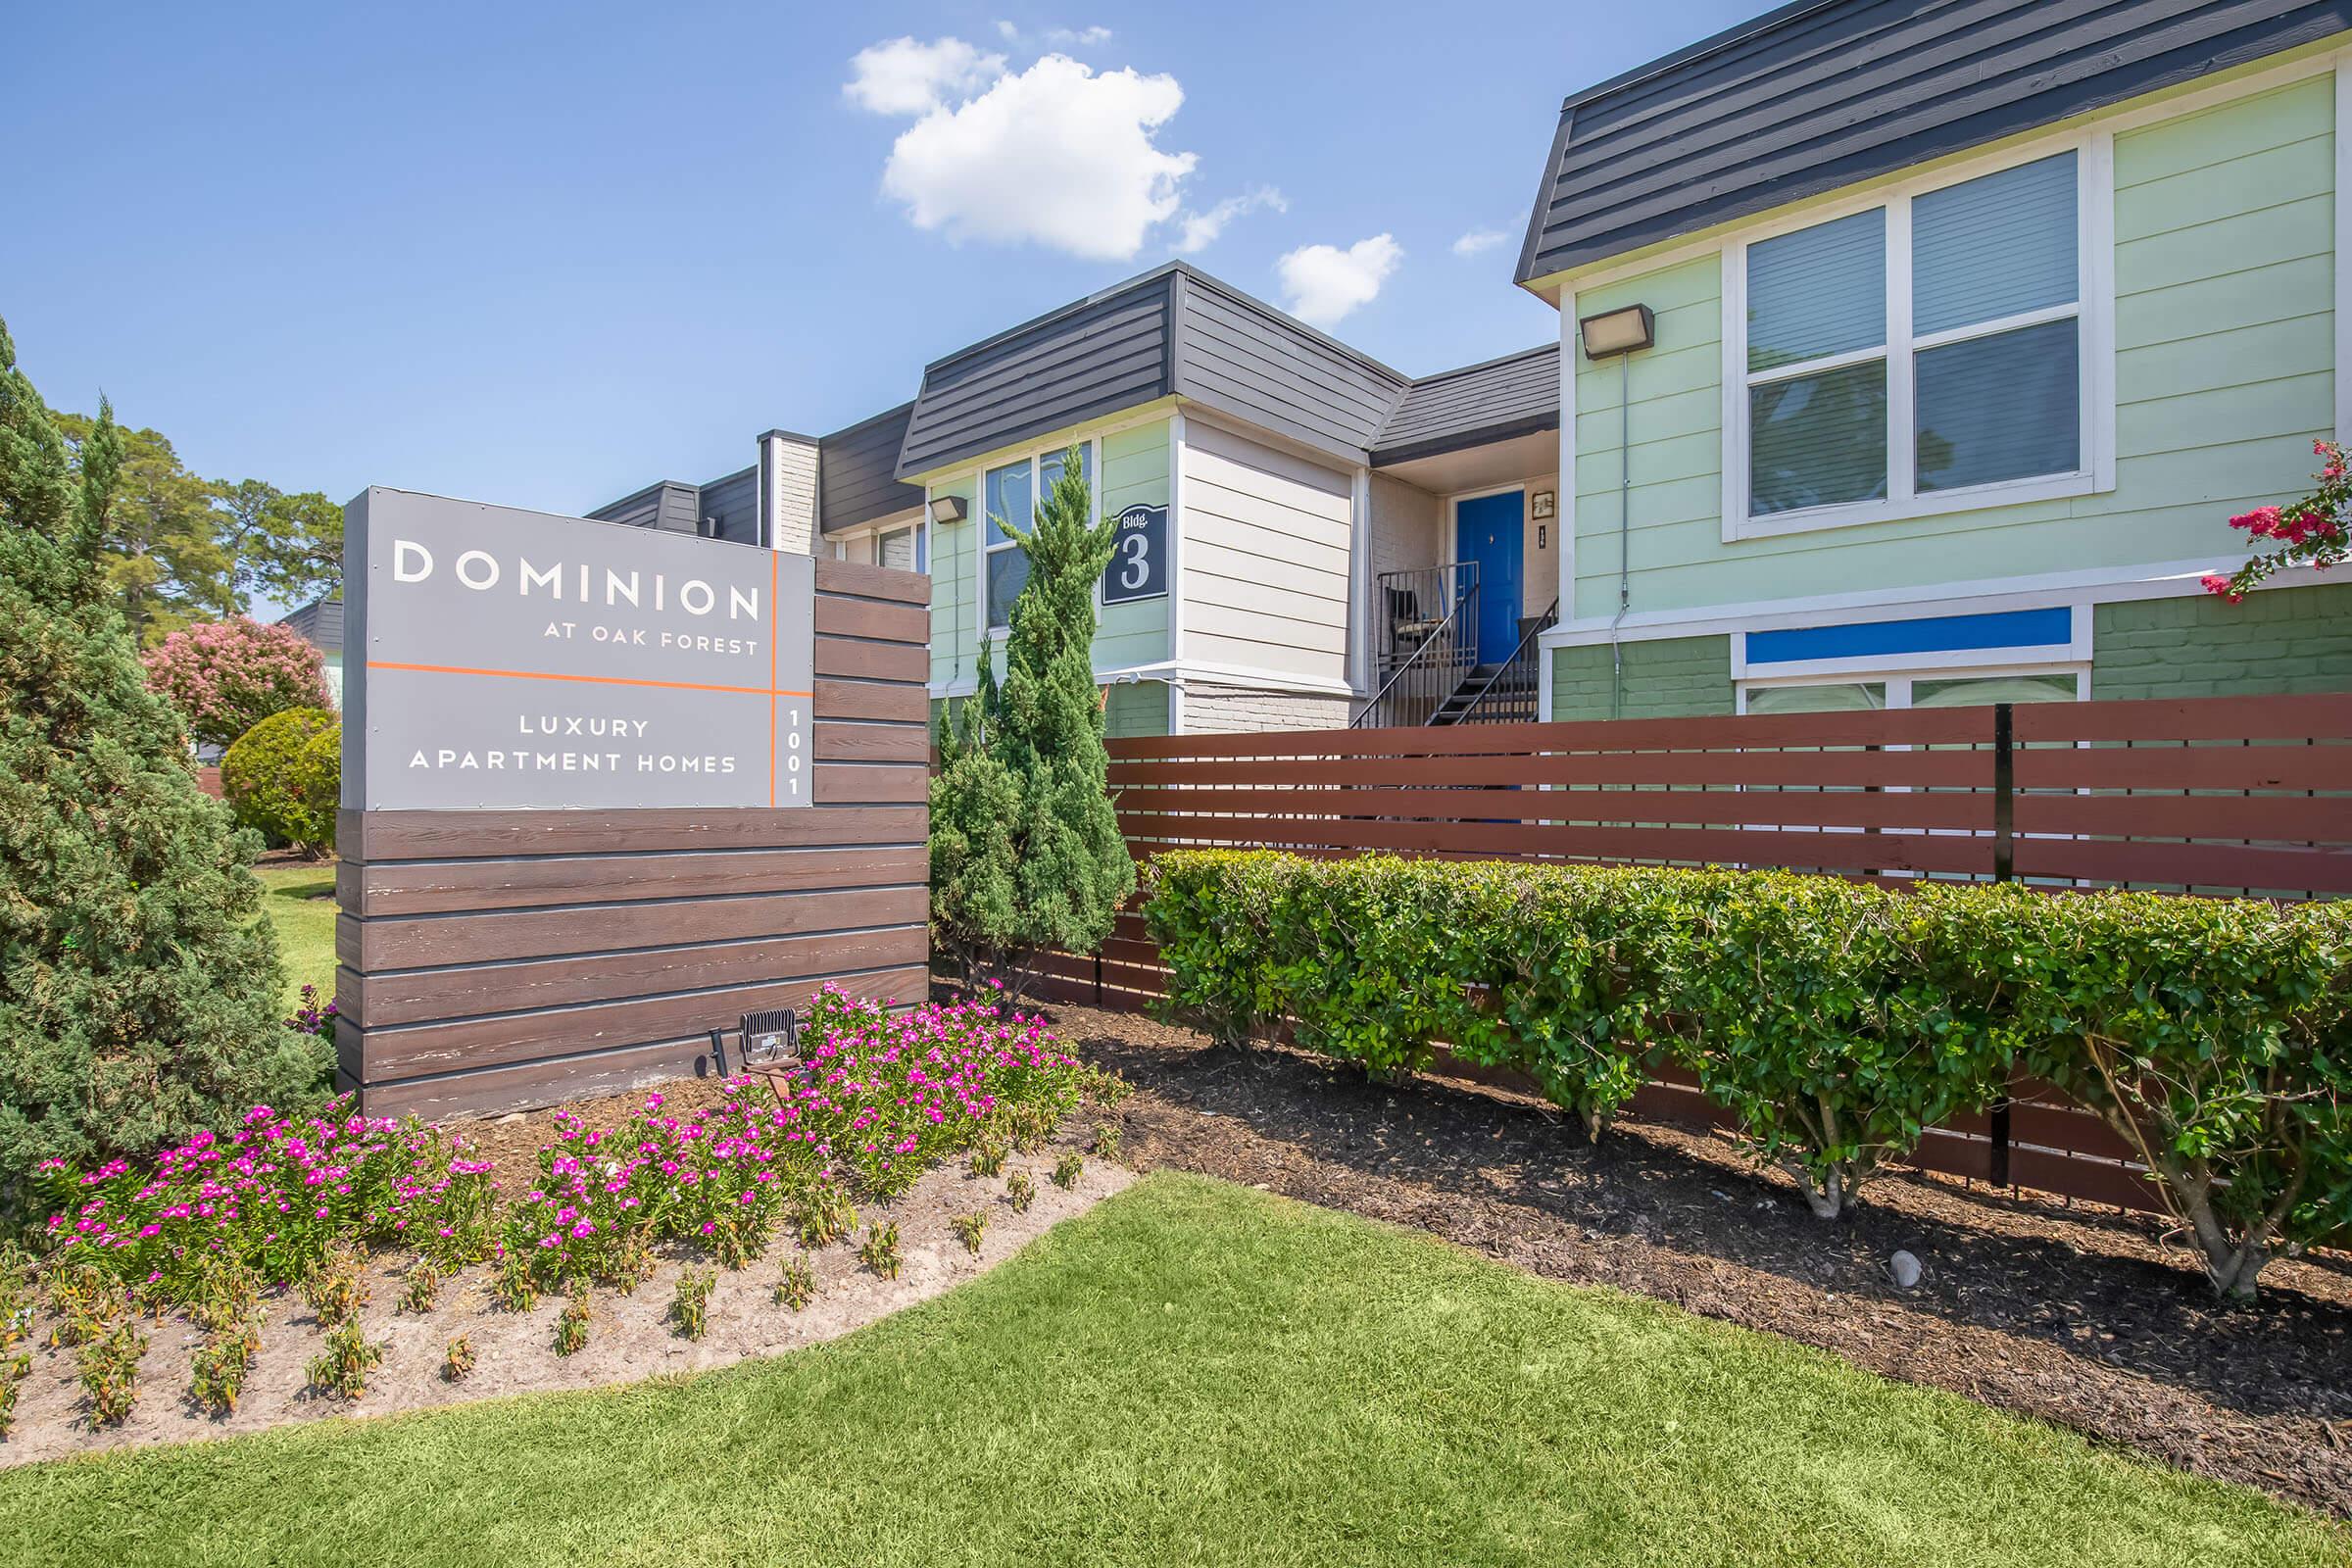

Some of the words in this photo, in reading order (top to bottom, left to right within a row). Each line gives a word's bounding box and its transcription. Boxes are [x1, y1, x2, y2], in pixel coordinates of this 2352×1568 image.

[1122, 514, 1148, 529] Bldg.
[1121, 533, 1150, 589] 3
[393, 539, 760, 620] DOMINION
[544, 621, 576, 639] AT
[592, 625, 646, 646] OAK
[661, 632, 758, 656] FOREST
[519, 714, 649, 738] LUXURY
[409, 749, 621, 771] APARTMENT
[637, 754, 736, 773] HOMES
[788, 710, 801, 795] 1001
